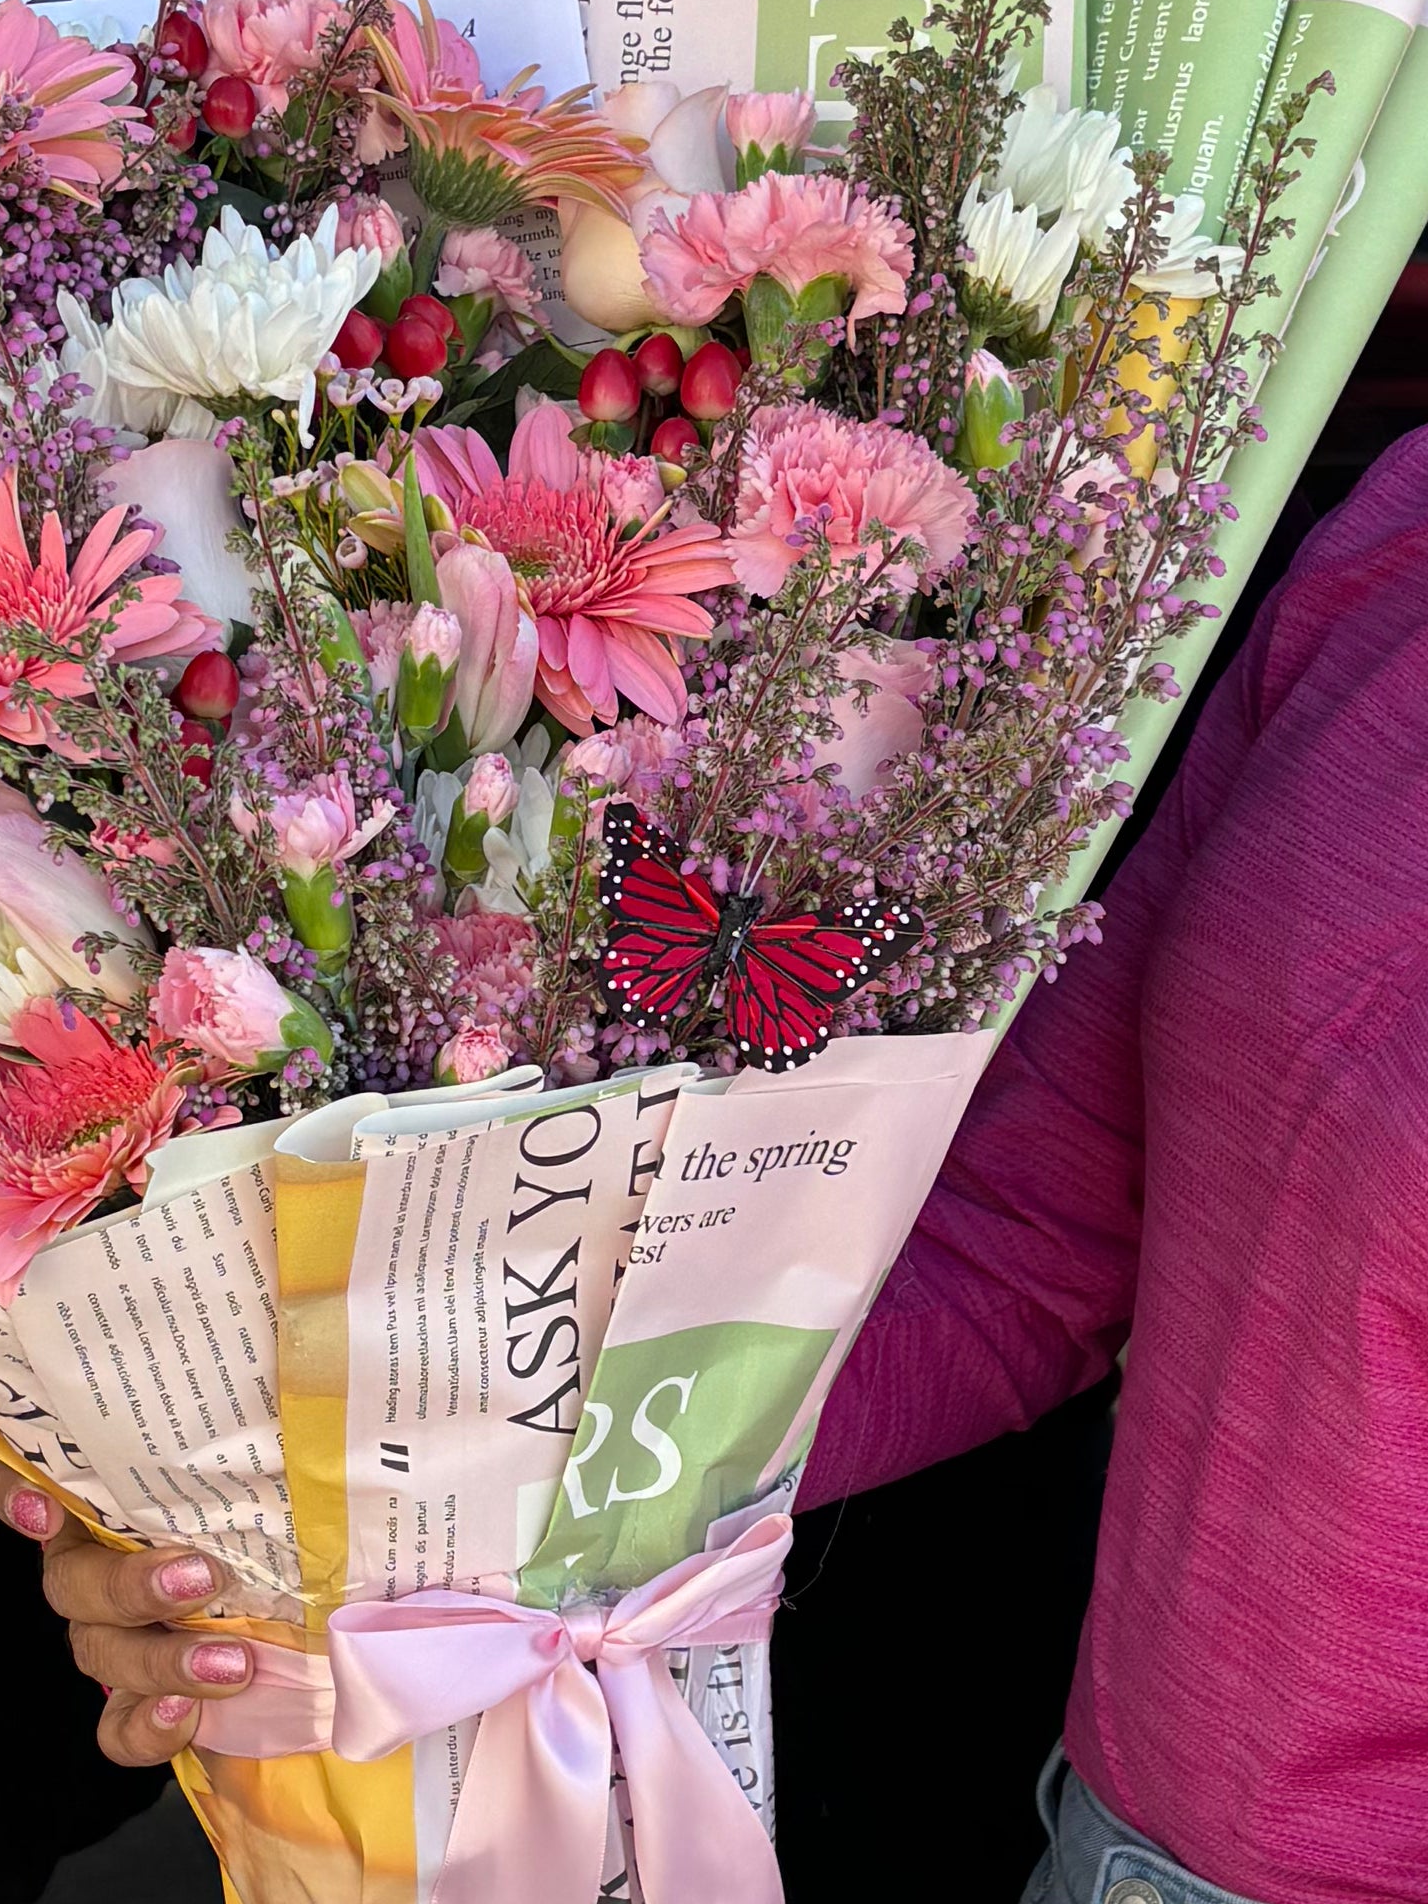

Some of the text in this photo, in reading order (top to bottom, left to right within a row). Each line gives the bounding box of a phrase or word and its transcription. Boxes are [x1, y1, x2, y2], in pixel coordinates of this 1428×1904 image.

[644, 25, 672, 72] the
[1139, 0, 1173, 81] turient
[675, 1122, 862, 1188] the spring
[696, 1203, 737, 1229] are
[385, 1290, 395, 1307] vel
[477, 1326, 489, 1389] consectetur
[506, 1228, 581, 1435] ASK
[444, 1493, 457, 1520] Nulla
